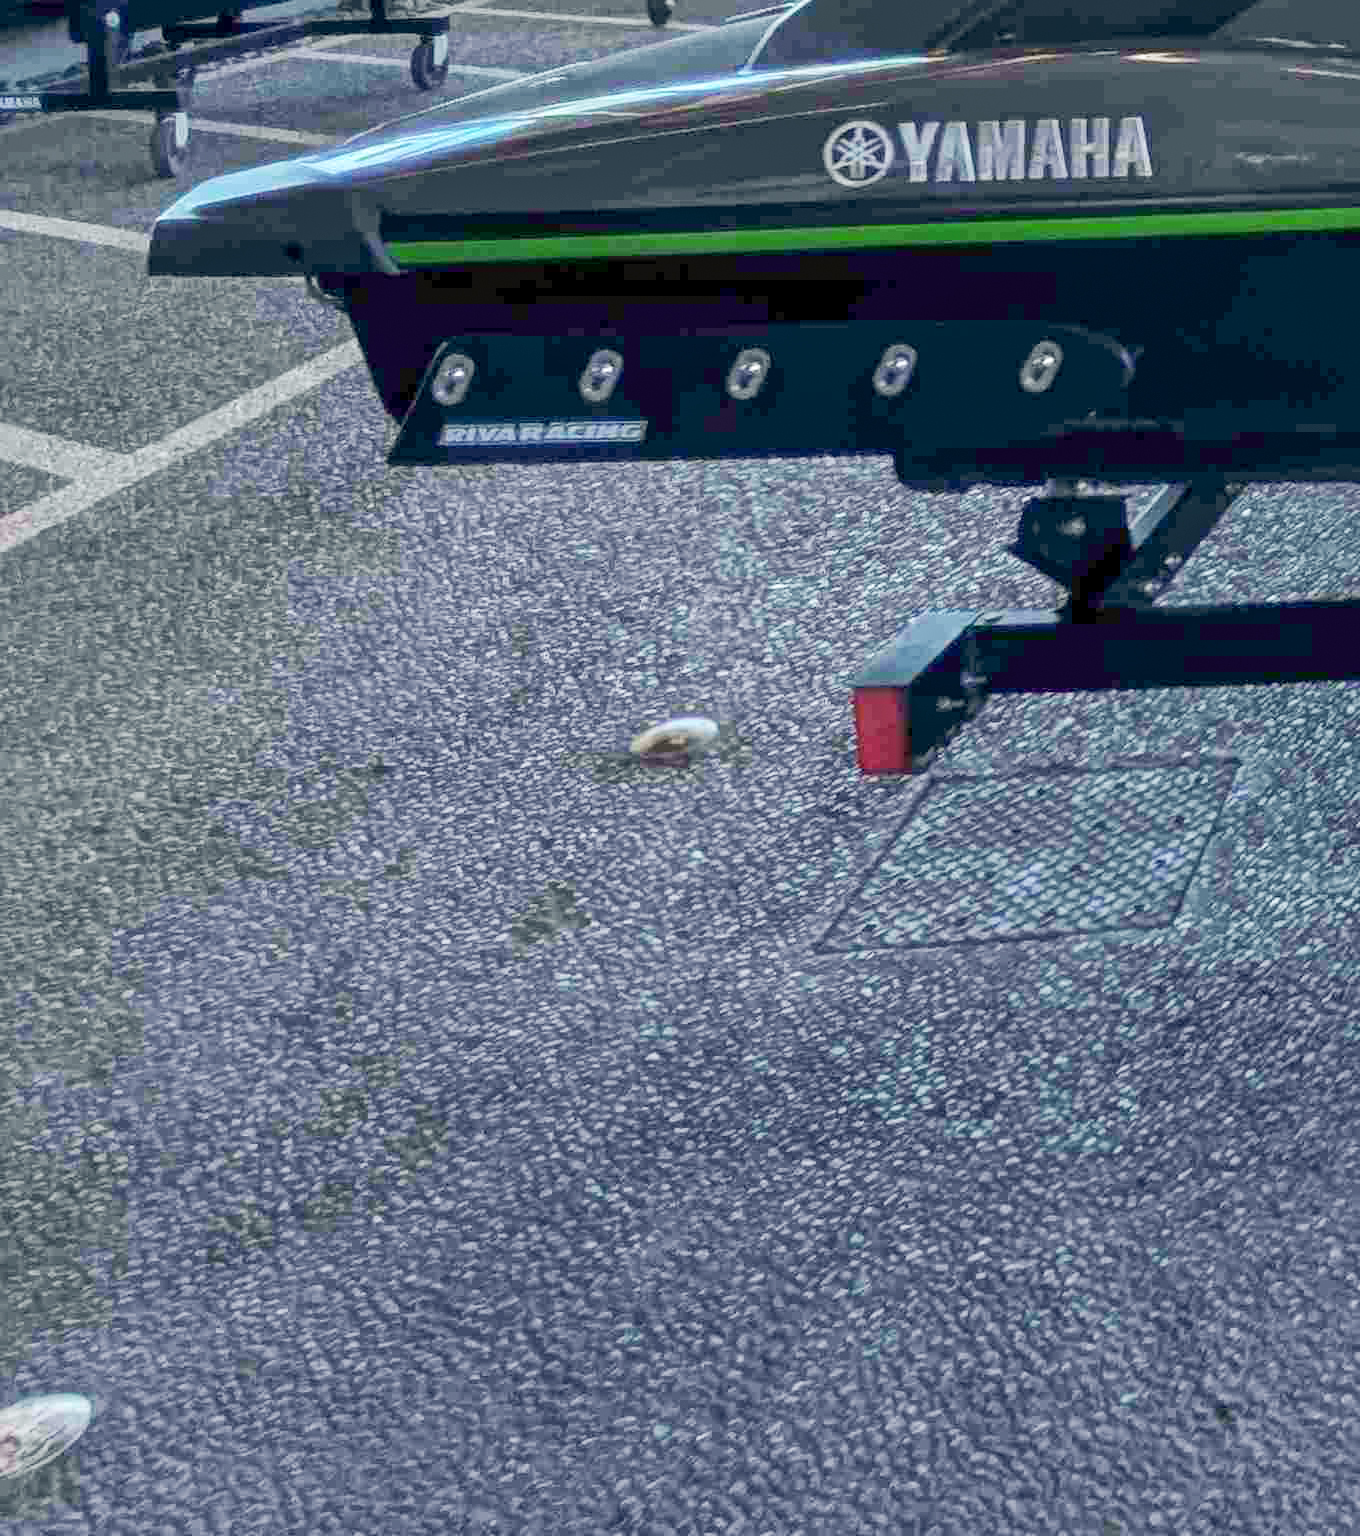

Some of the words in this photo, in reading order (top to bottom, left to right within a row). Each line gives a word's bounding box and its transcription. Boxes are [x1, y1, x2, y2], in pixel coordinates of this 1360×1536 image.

[897, 117, 1153, 184] YAMAHA
[445, 421, 518, 444] RIVA
[519, 420, 644, 443] RACING
